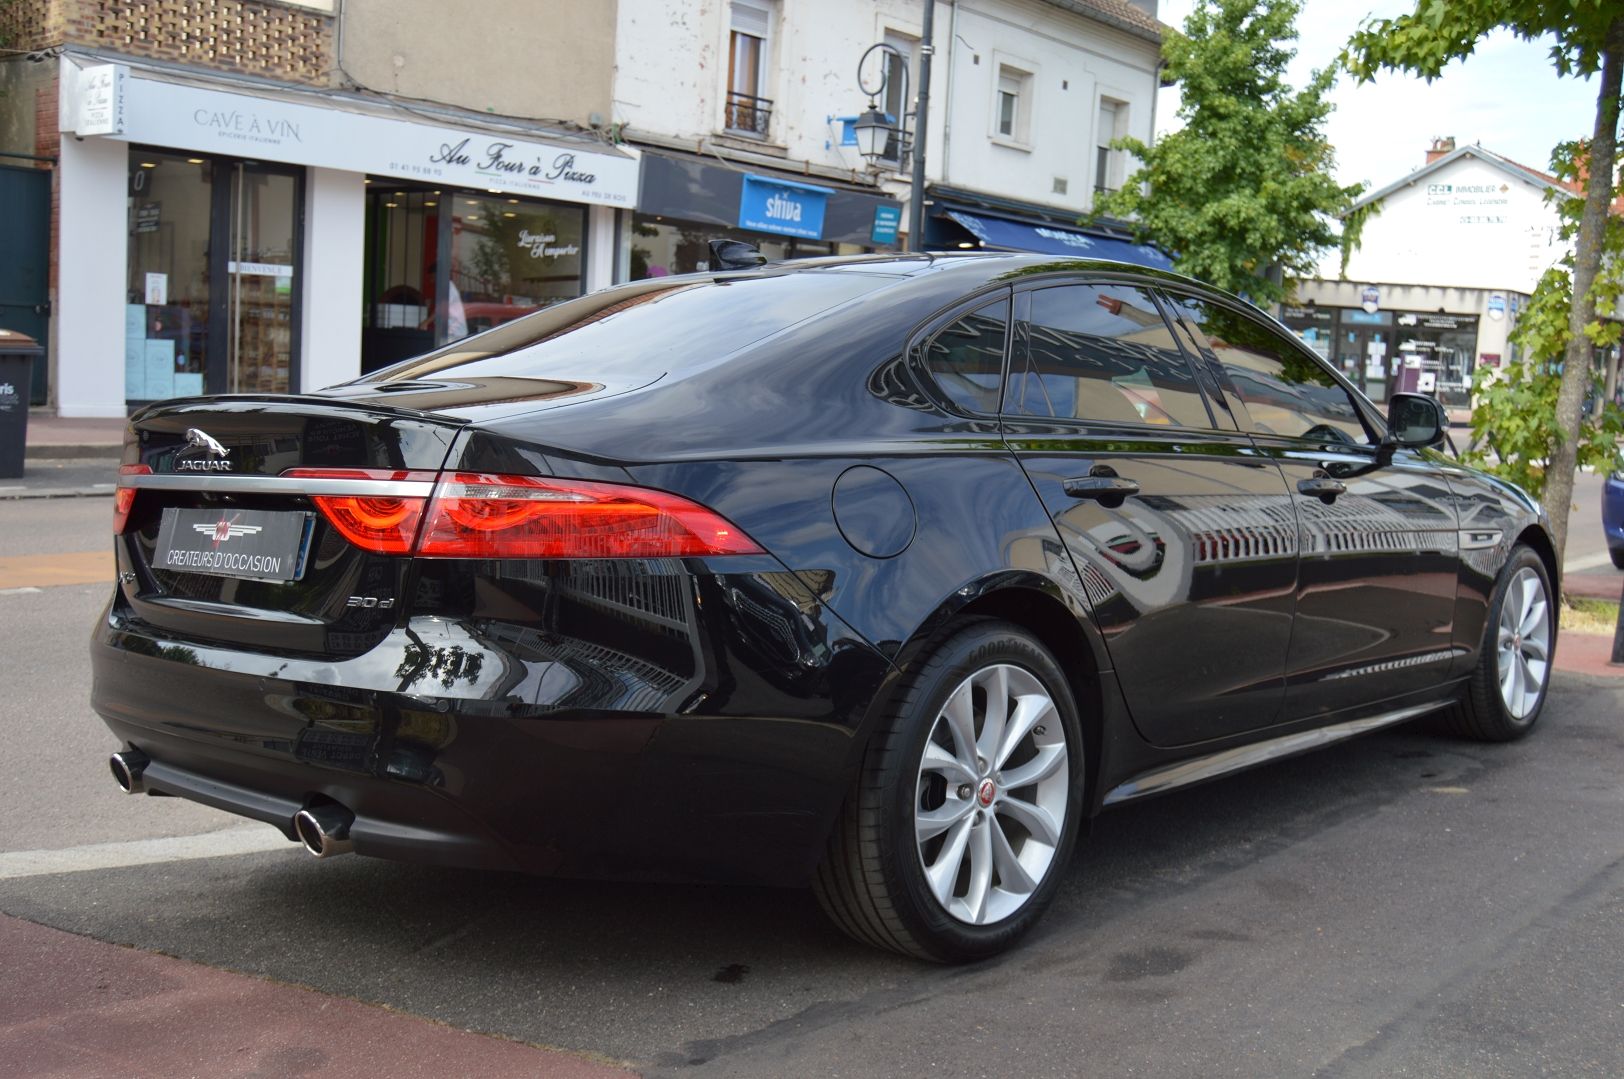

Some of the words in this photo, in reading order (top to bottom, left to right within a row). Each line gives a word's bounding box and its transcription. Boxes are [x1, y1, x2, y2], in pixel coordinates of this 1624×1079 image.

[193, 108, 244, 131] CAVE
[266, 119, 303, 143] VIN
[429, 138, 471, 165] Au
[477, 142, 526, 173] Four
[528, 156, 542, 175] à
[545, 153, 596, 184] Pizza
[765, 191, 802, 222] shiva
[177, 460, 232, 471] JAGUAR
[213, 552, 281, 573] D'OCCASION
